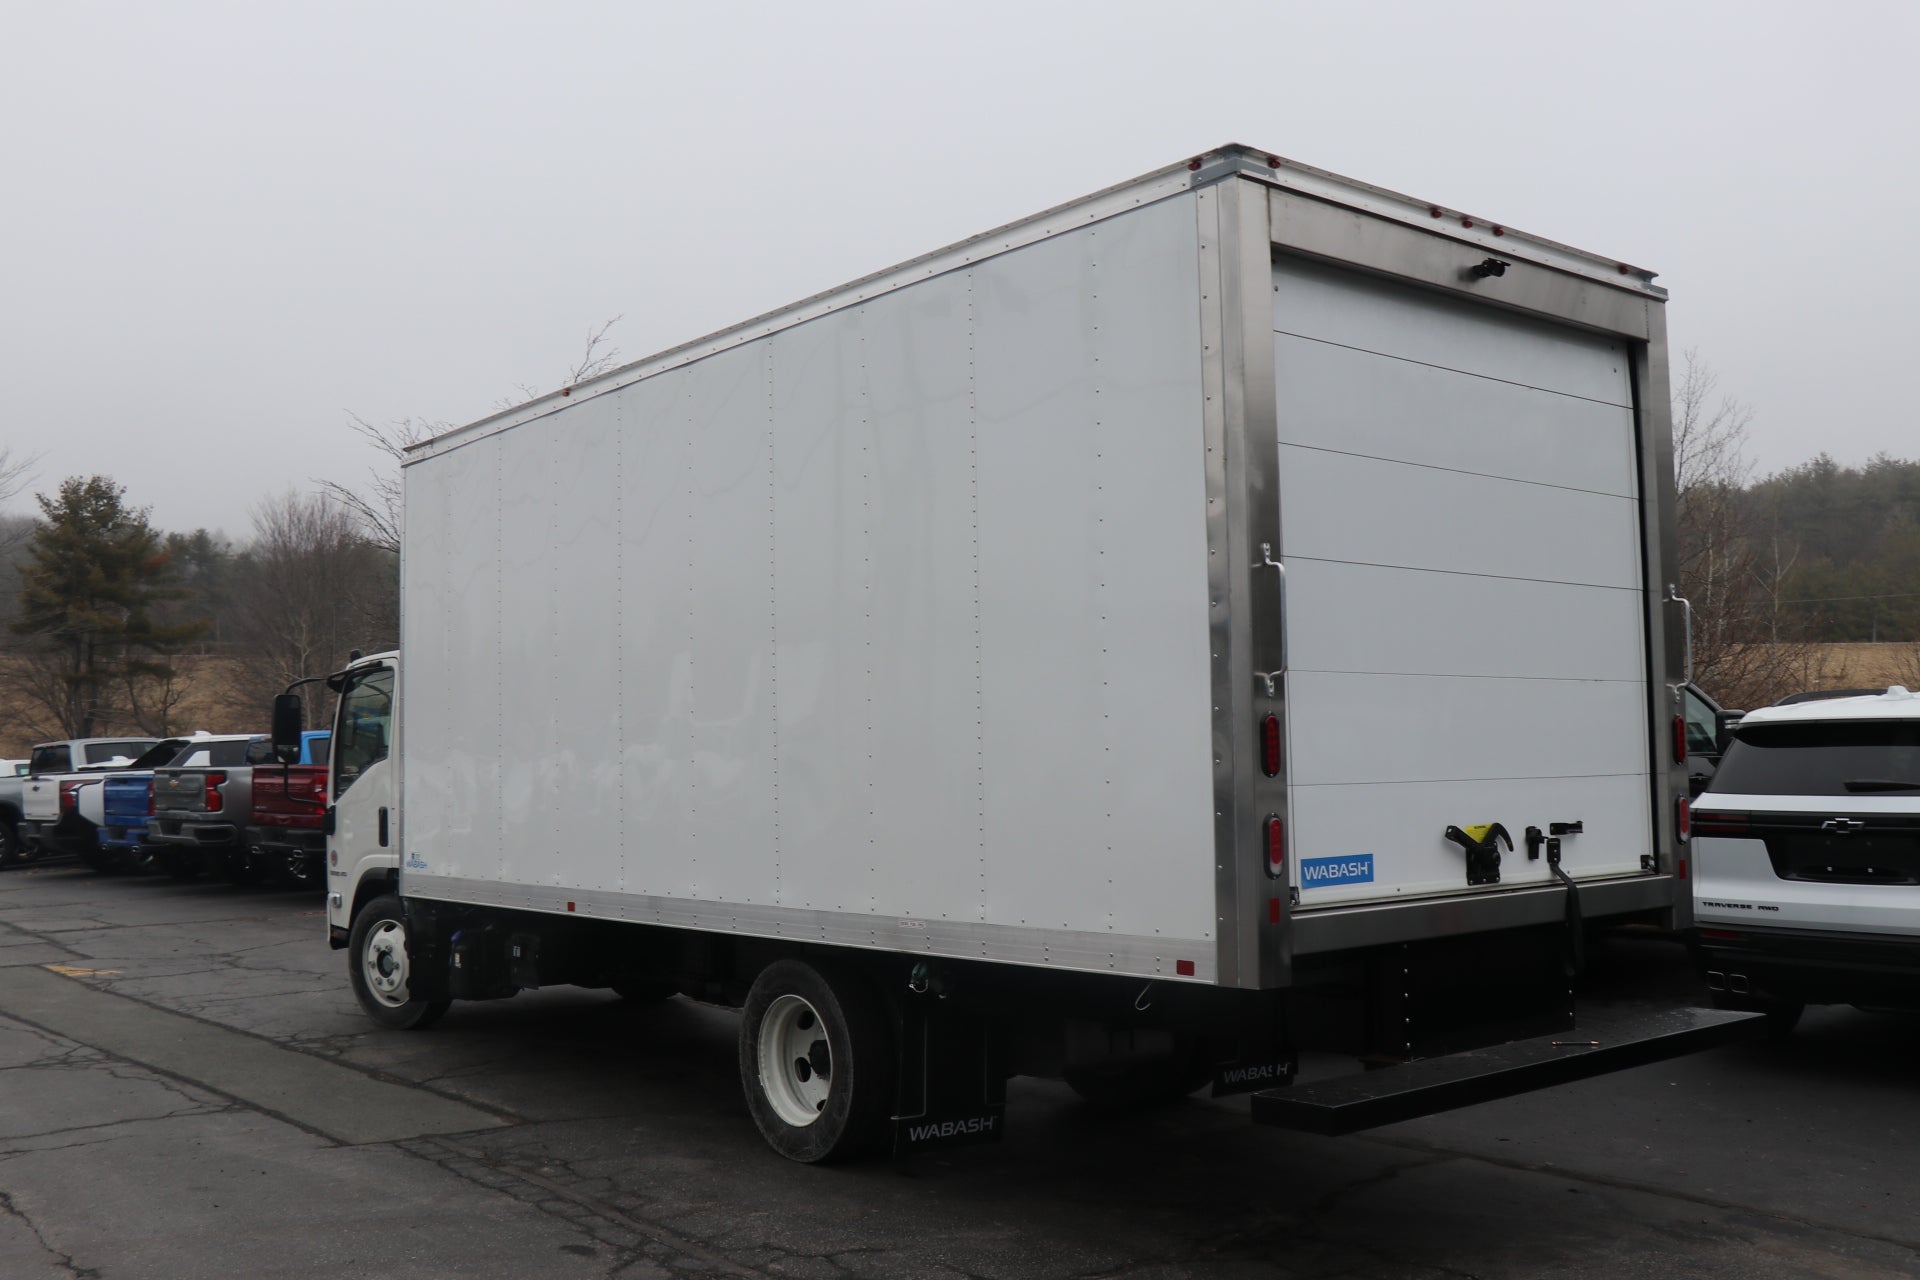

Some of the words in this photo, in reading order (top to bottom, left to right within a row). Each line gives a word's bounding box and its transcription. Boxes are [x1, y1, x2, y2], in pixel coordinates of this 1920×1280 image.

[1304, 861, 1369, 881] WABASH
[1702, 901, 1752, 910] TRAVERSE
[910, 1116, 994, 1142] WABASH
